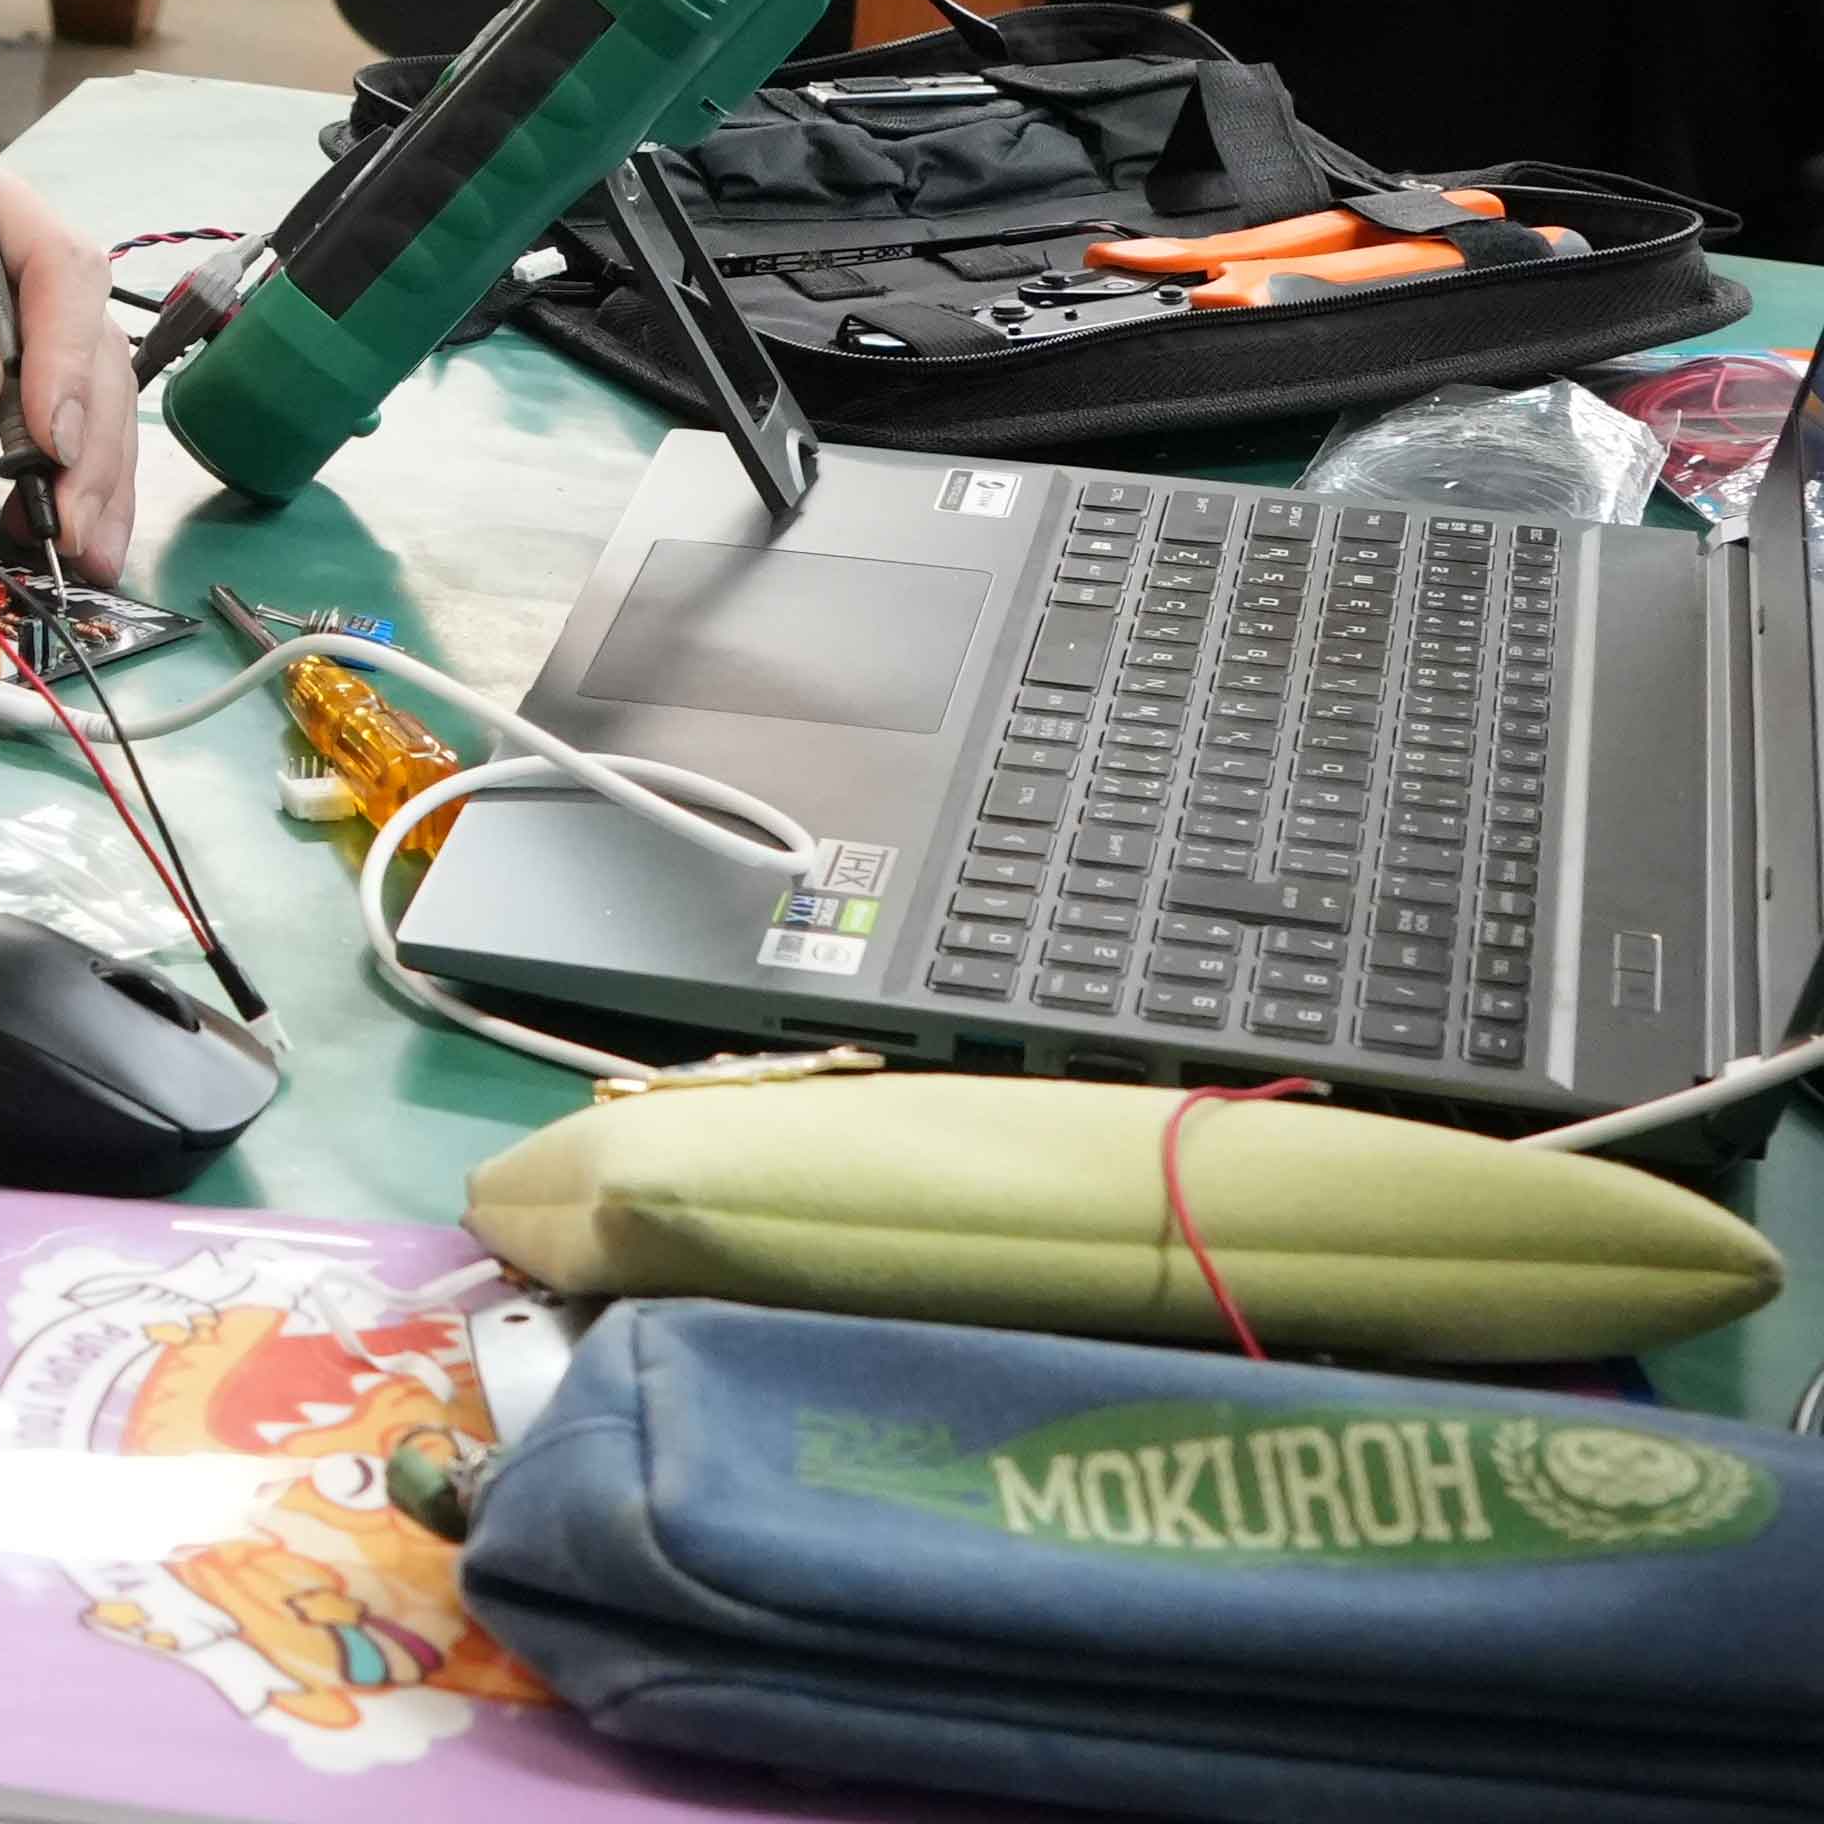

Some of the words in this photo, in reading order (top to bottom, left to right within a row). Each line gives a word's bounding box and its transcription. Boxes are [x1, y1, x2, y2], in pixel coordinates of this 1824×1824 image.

[1138, 705, 1159, 716] M
[1229, 730, 1250, 741] K
[824, 845, 889, 892] THX
[1206, 925, 1230, 936] 4
[987, 932, 1012, 944] 0
[1310, 938, 1333, 950] 7
[1092, 945, 1118, 958] 2
[1198, 958, 1223, 971] 5
[1303, 973, 1328, 985] 8
[1083, 982, 1109, 994] 3
[1190, 995, 1216, 1008] 6
[1296, 1009, 1322, 1022] 9
[991, 1421, 1492, 1550] MOKUROH
